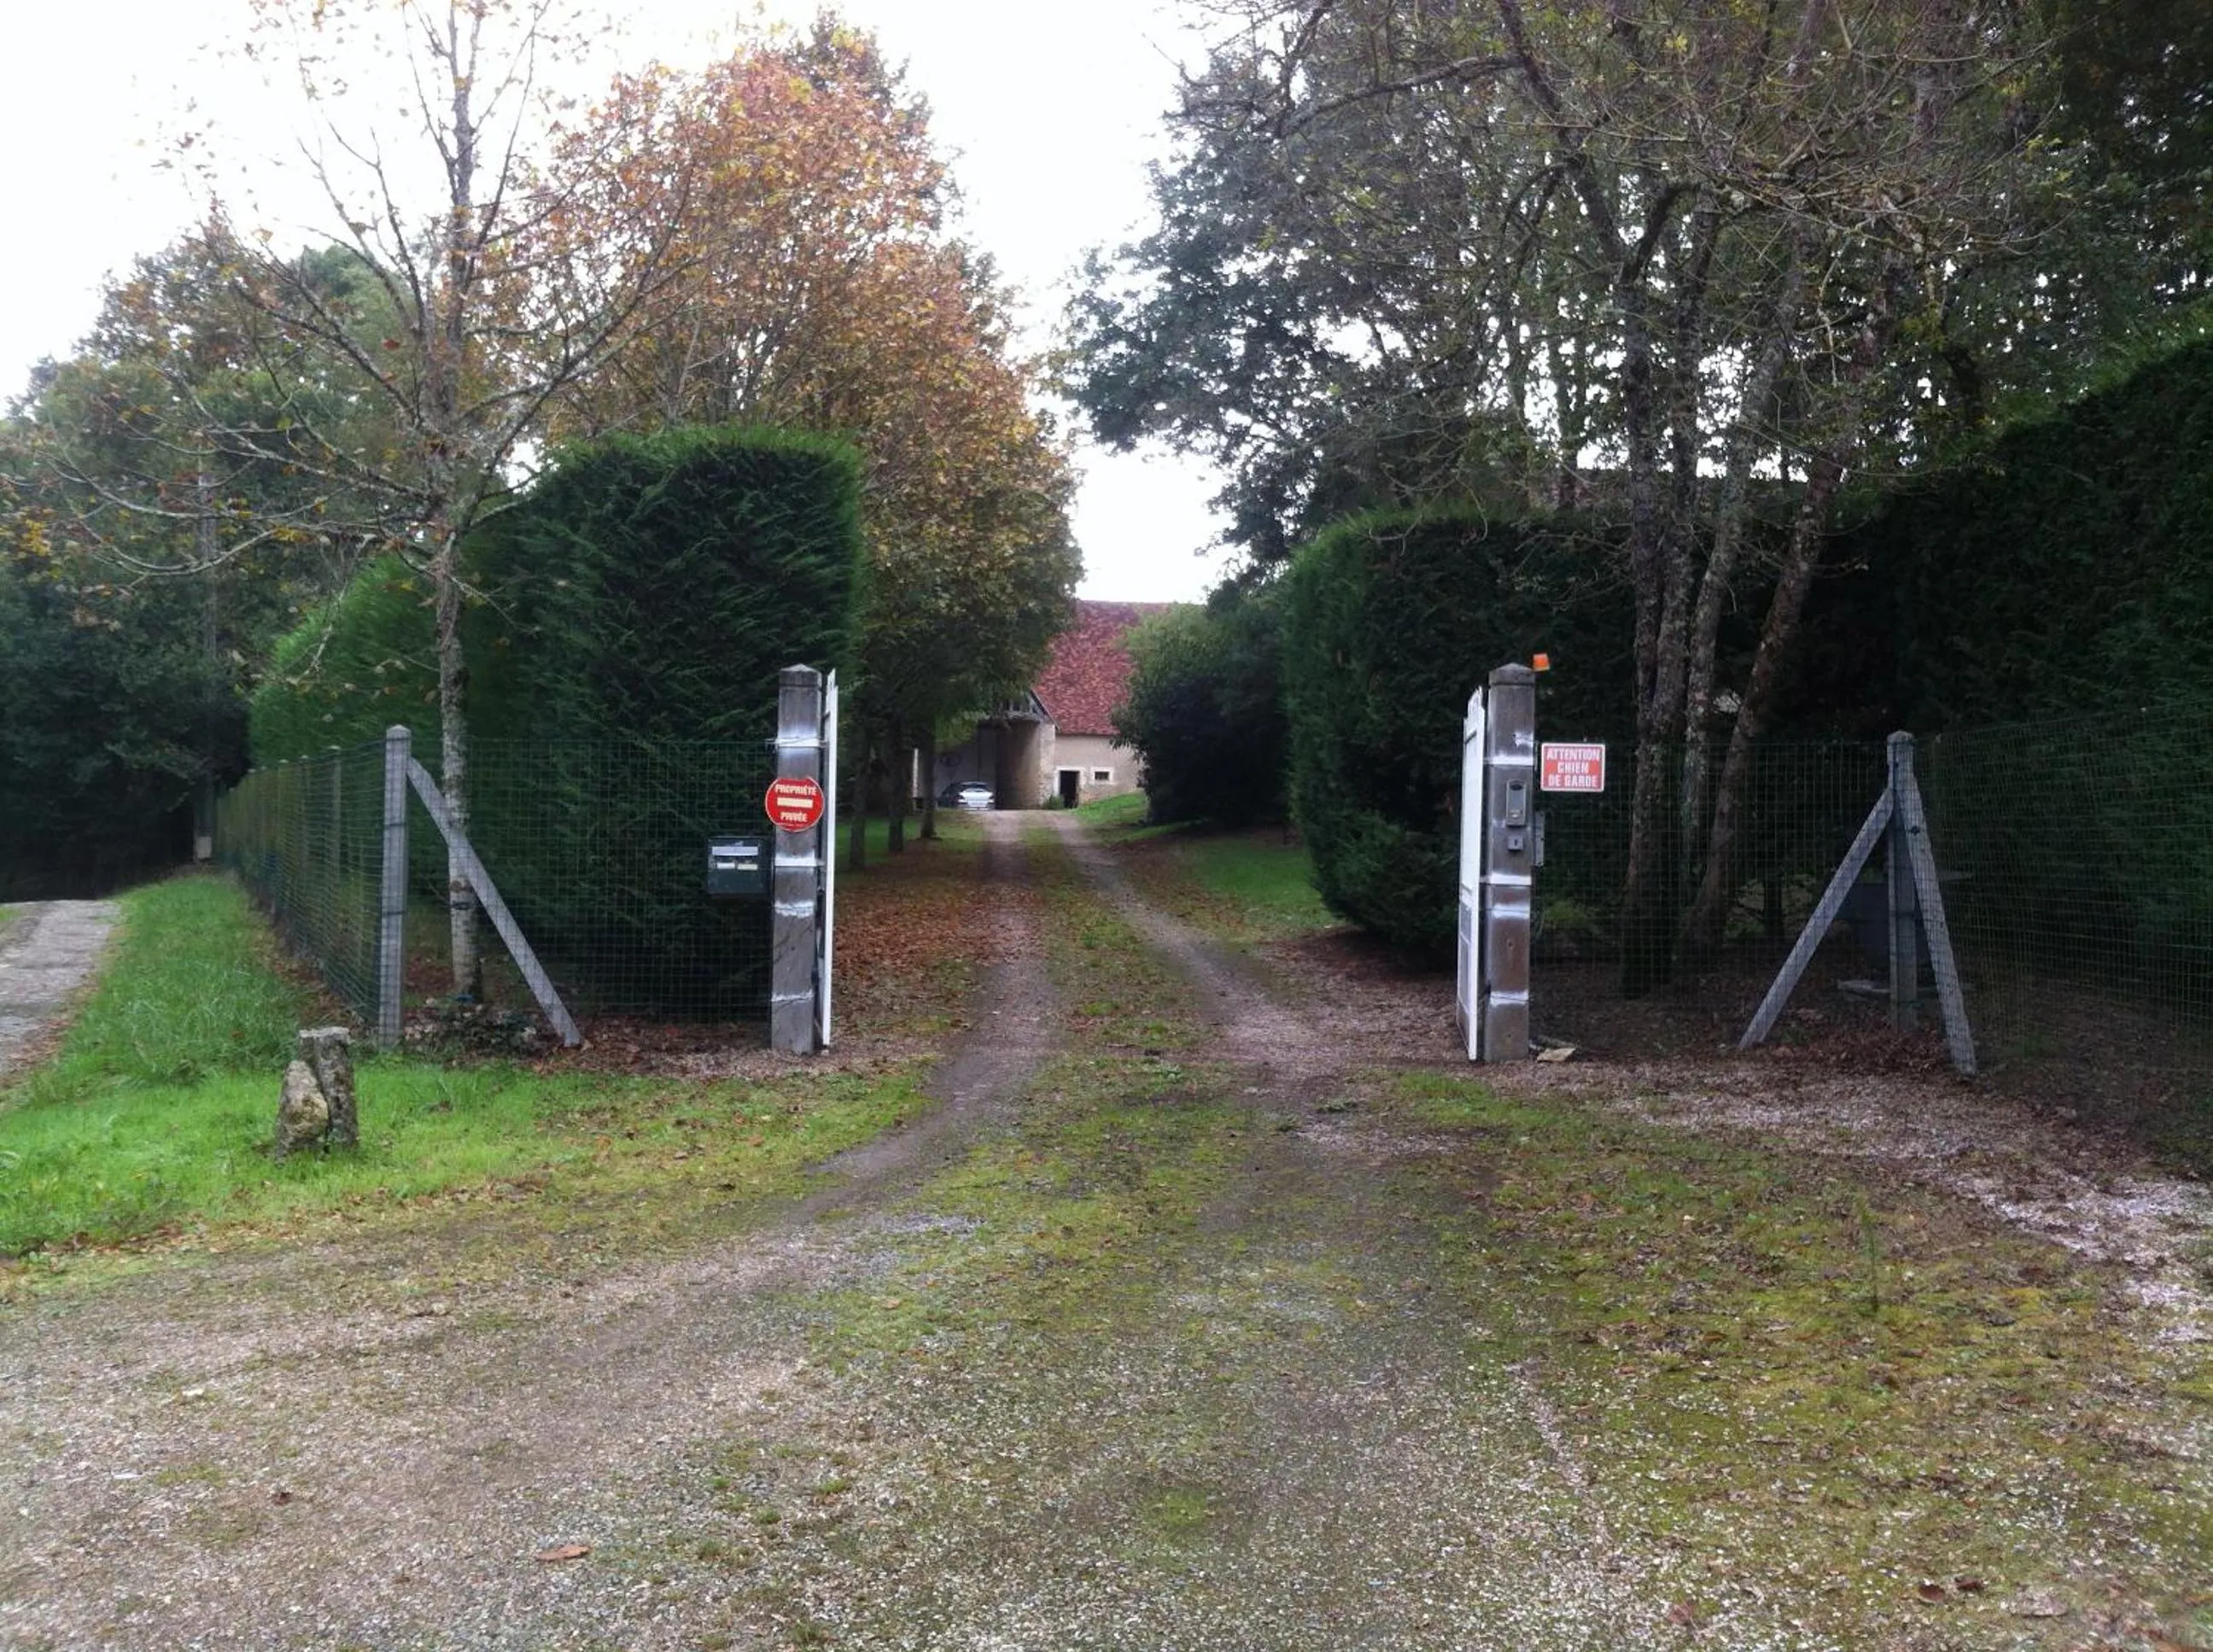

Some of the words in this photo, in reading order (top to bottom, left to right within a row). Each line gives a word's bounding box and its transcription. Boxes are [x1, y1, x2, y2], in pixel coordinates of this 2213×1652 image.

[1546, 748, 1600, 762] ATTENTION
[1557, 762, 1589, 773] CHIEN
[1548, 773, 1561, 786] DE
[1564, 774, 1598, 787] GARDE
